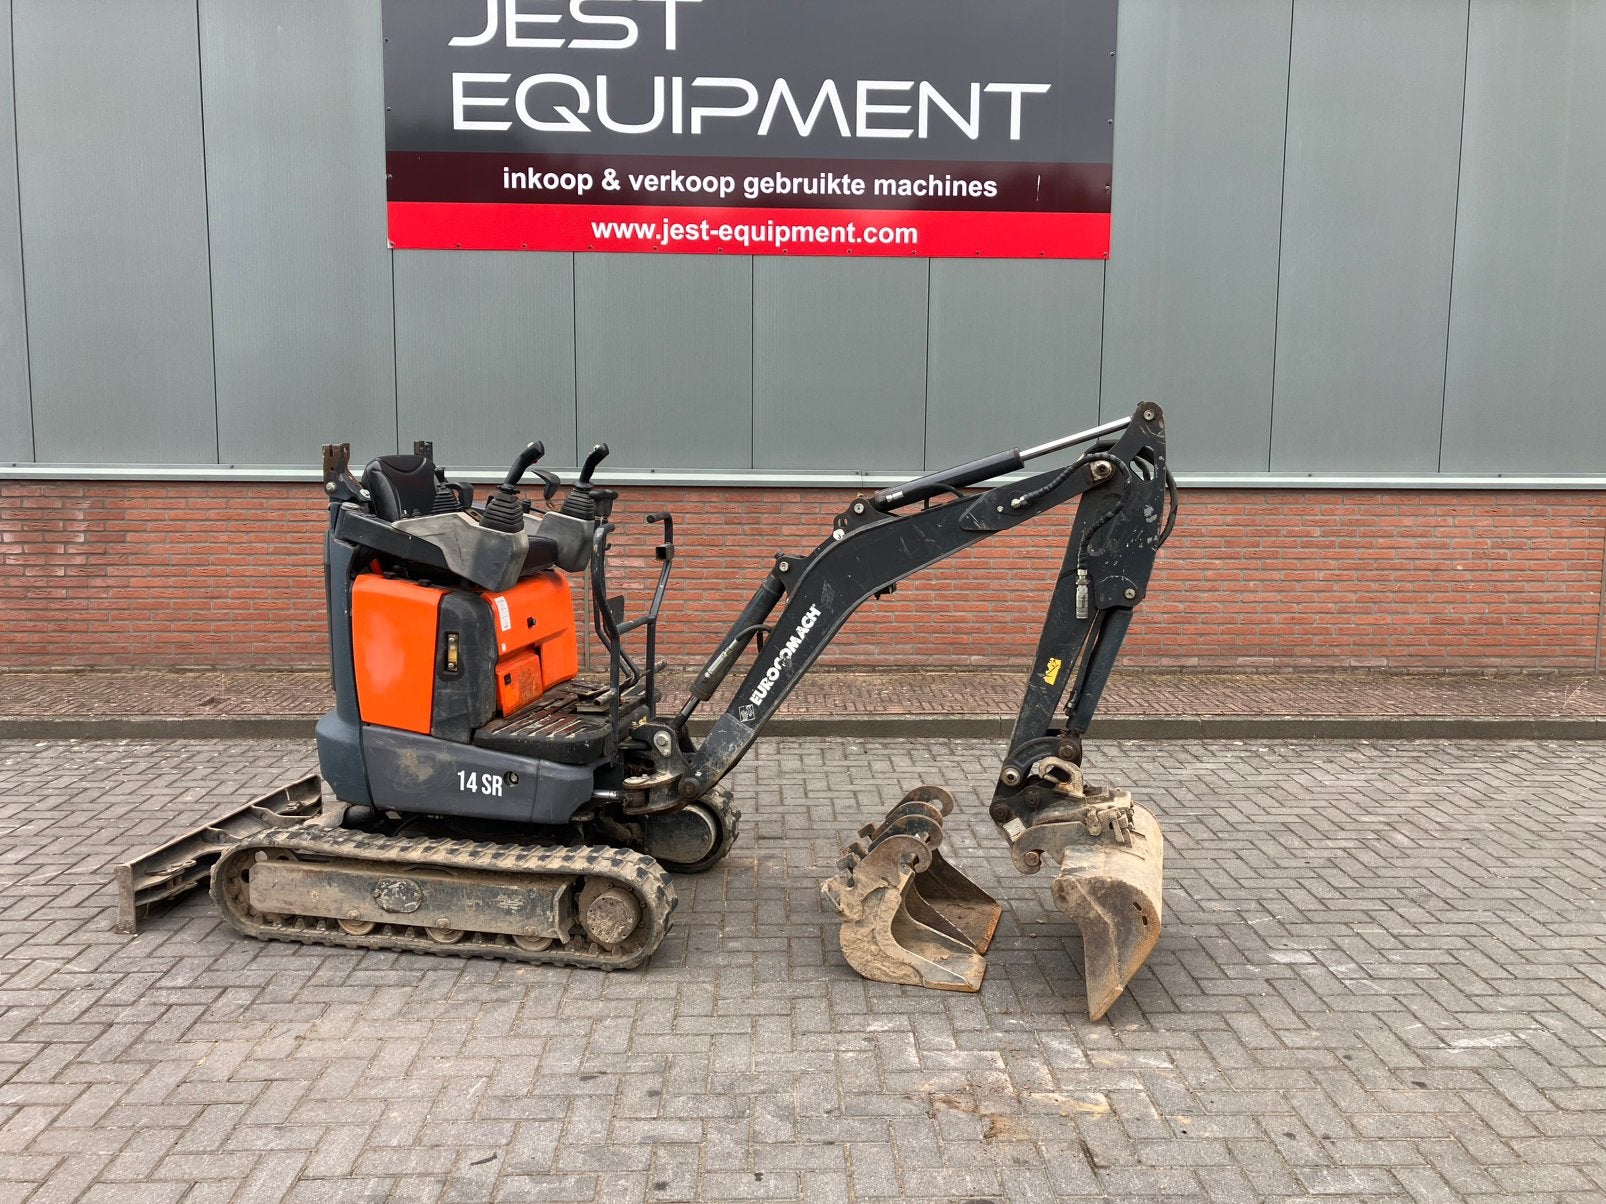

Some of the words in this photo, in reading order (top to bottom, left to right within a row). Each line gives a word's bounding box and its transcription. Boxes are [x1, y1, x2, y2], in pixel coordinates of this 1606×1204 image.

[448, 0, 704, 51] JEST
[451, 72, 1052, 141] EQUIPMENT
[503, 166, 594, 196] inkoop
[601, 167, 621, 191] &
[628, 169, 736, 199] verkoop
[743, 171, 866, 200] gebruikte
[873, 174, 998, 198] machines
[591, 217, 918, 247] www.jest-equipment.com
[749, 604, 822, 707] EUROCOMACH
[457, 770, 478, 793] 14
[481, 773, 503, 797] SR
